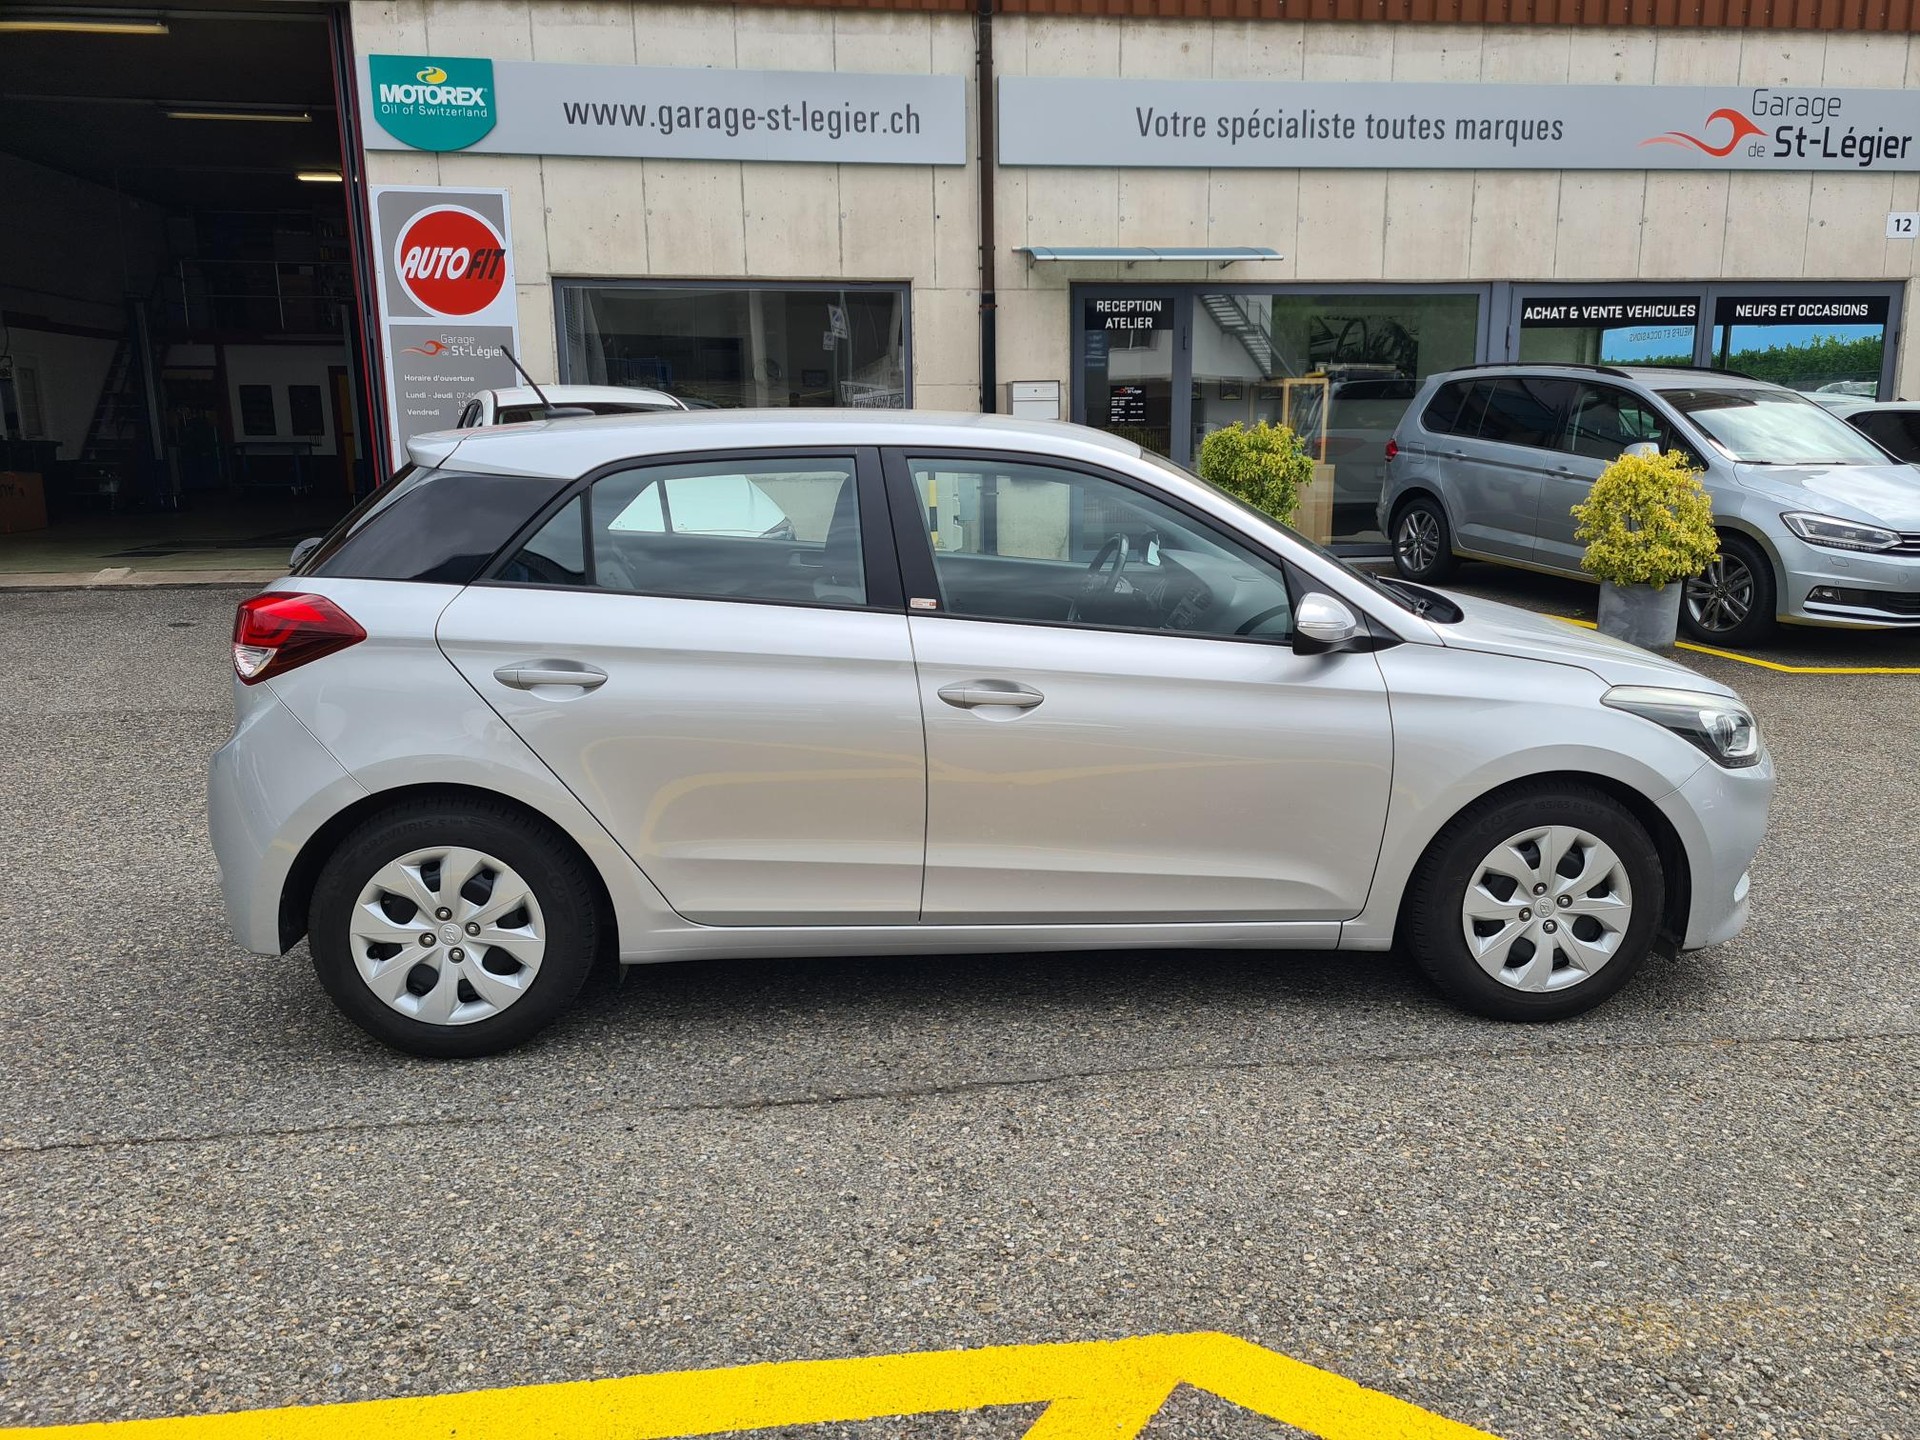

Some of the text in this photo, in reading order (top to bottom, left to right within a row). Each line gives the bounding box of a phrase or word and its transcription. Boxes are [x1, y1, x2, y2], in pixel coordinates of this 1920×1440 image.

[379, 84, 485, 106] MOTOREX
[381, 104, 487, 118] Oil of Switzerland
[1752, 88, 1842, 124] Garage
[563, 101, 921, 139] www.garage-st-legier.ch
[1136, 107, 1564, 147] Votre spécialiste toutes marques
[1747, 125, 1913, 167] de St-Légier
[1894, 218, 1912, 232] 12
[401, 246, 506, 280] AUTOFIT
[1096, 300, 1162, 312] RECEPTION
[1524, 305, 1696, 320] ACHAT & VENTE VEHICULES
[1736, 304, 1869, 317] NEUFS ET OCCASIONS
[1105, 317, 1153, 329] ATELIER
[440, 334, 475, 346] Garage
[404, 374, 475, 382] Horaire d'ouverture
[405, 391, 426, 399] Lundi
[432, 391, 453, 399] Jeudi
[407, 408, 440, 416] Vendredi
